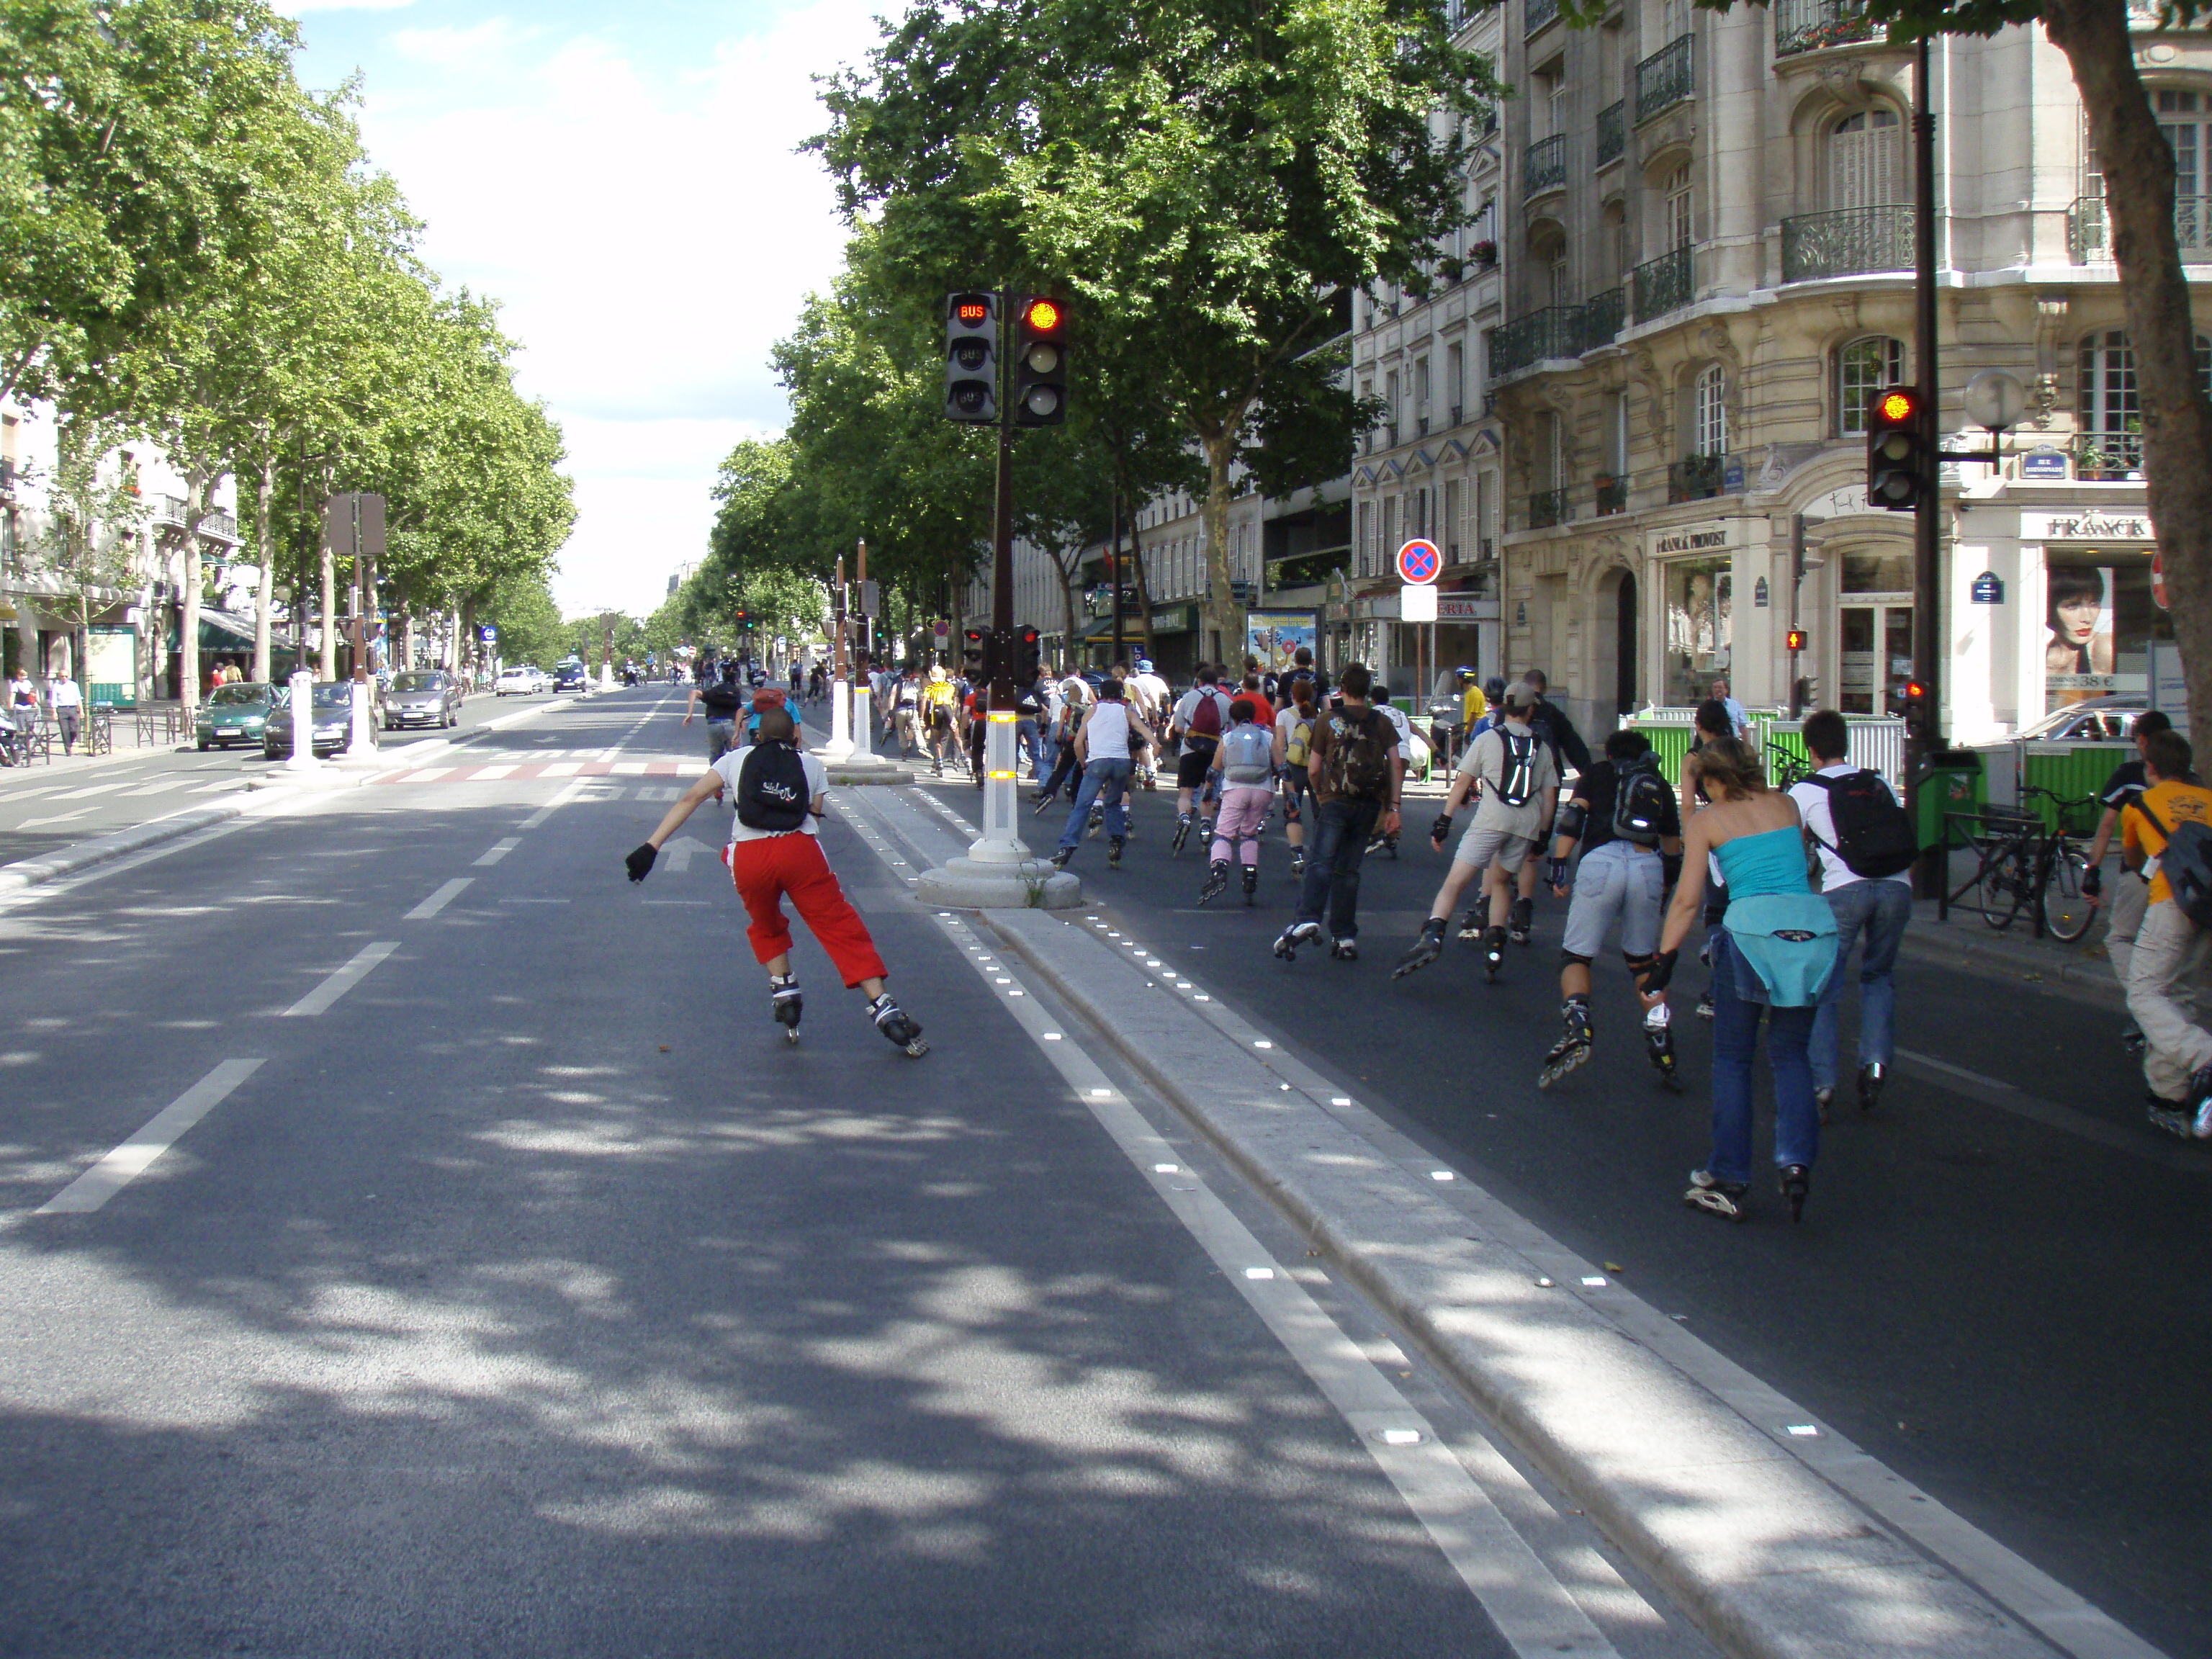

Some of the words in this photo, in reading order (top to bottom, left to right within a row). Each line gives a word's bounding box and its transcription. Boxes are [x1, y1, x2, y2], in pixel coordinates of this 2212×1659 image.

[961, 306, 984, 317] BUS
[2080, 675, 2099, 687] 38
[2103, 675, 2114, 687] €
